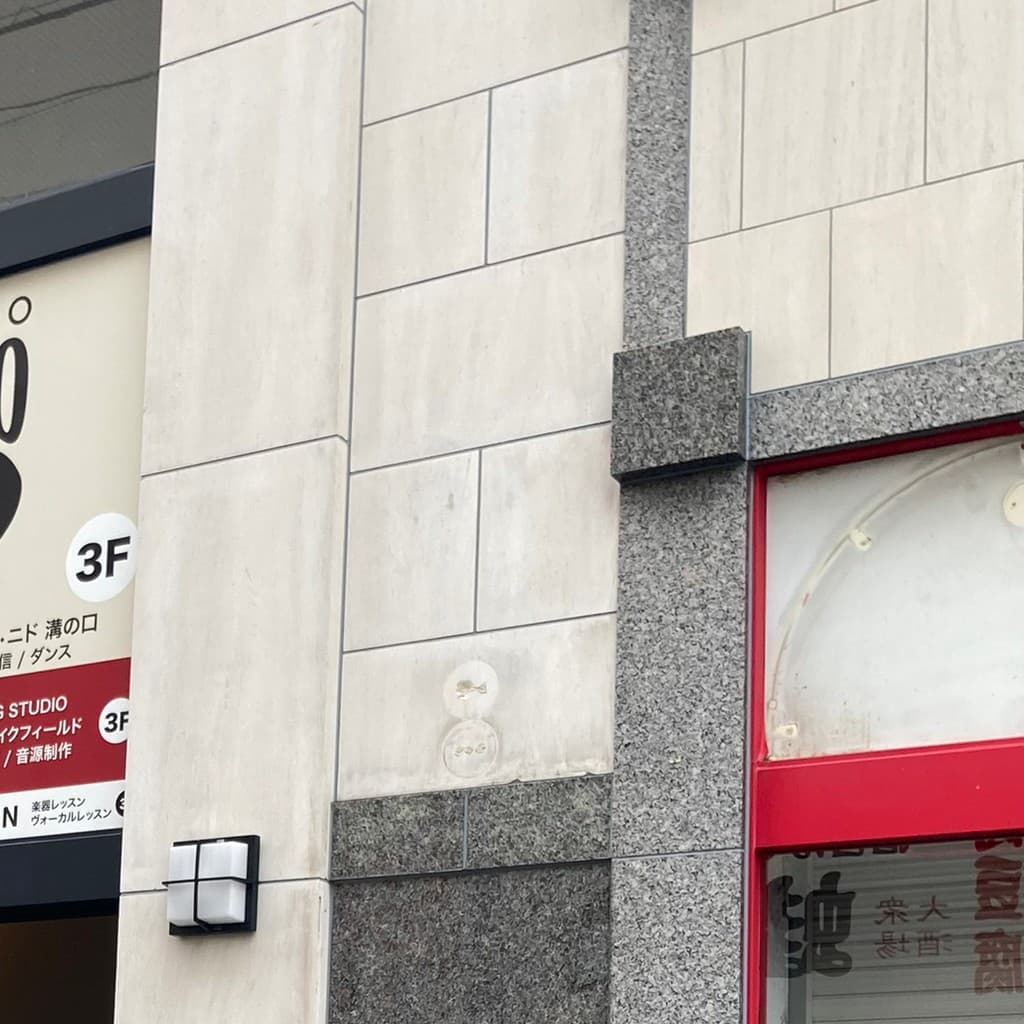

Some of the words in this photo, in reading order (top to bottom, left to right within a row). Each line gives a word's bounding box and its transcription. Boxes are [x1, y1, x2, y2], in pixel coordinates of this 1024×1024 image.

[75, 535, 132, 583] 3F
[44, 613, 99, 640] 溝の口
[8, 695, 68, 719] STUDIO
[31, 797, 86, 813] 楽器レッスン
[31, 808, 112, 826] ヴォーカルレッスン
